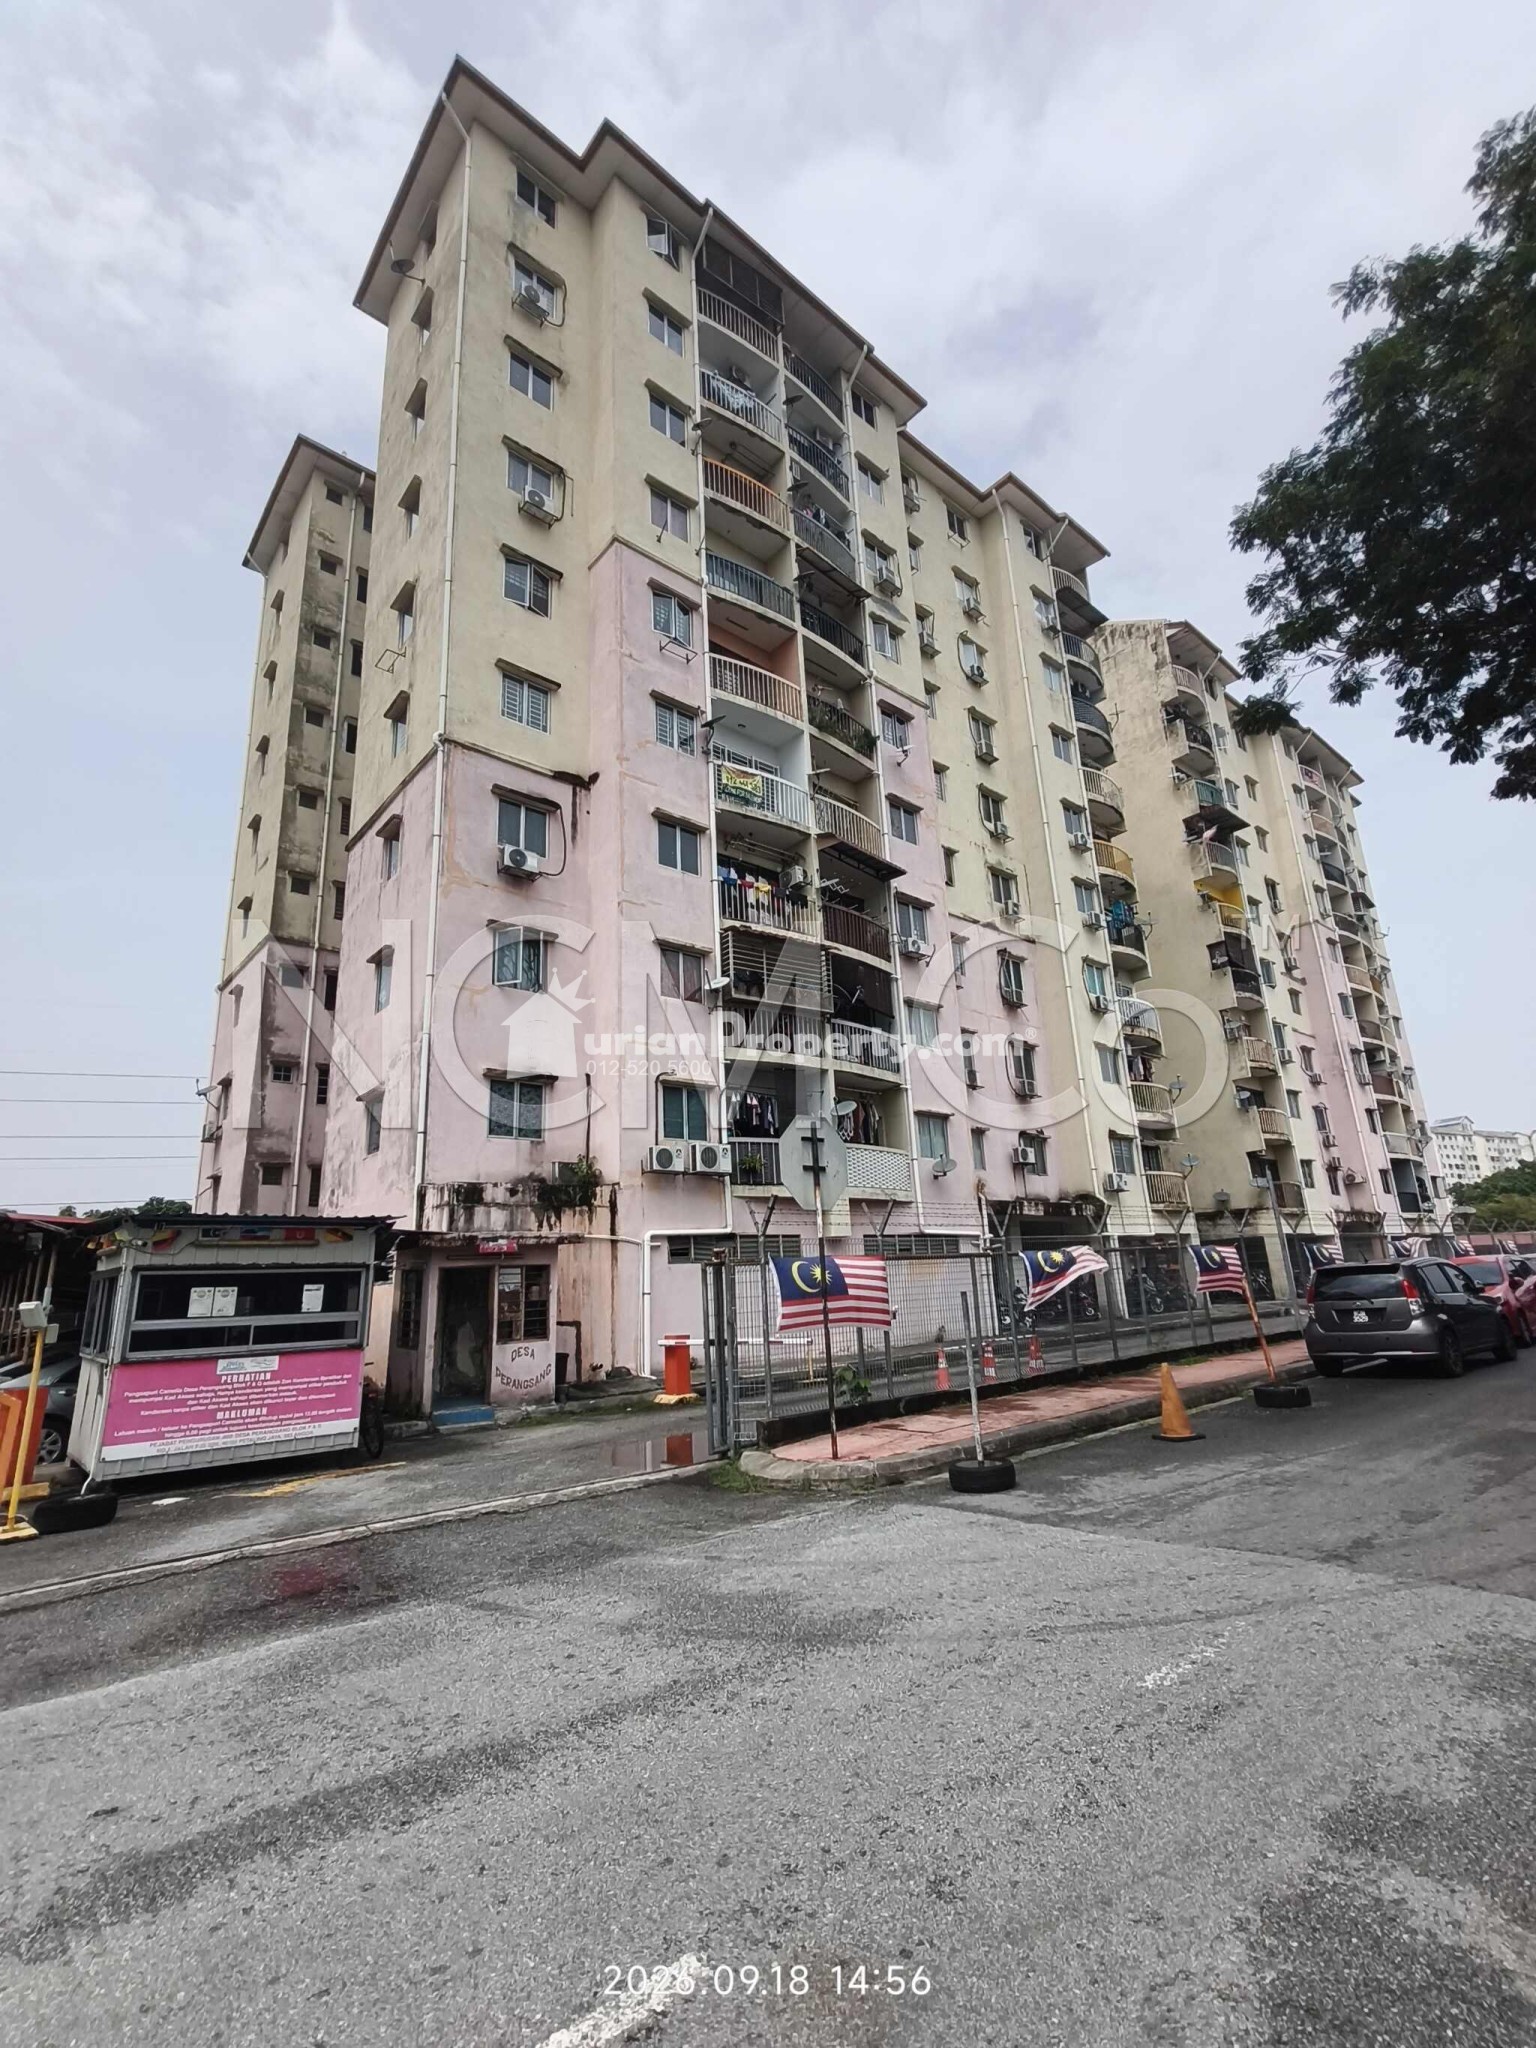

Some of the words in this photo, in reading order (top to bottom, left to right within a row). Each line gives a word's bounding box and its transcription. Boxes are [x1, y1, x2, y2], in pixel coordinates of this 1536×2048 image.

[511, 1346, 535, 1362] DESA
[221, 1373, 271, 1383] PERHATIAN
[495, 1363, 552, 1390] PERANGSANG
[217, 1407, 268, 1419] MAKLUMAN
